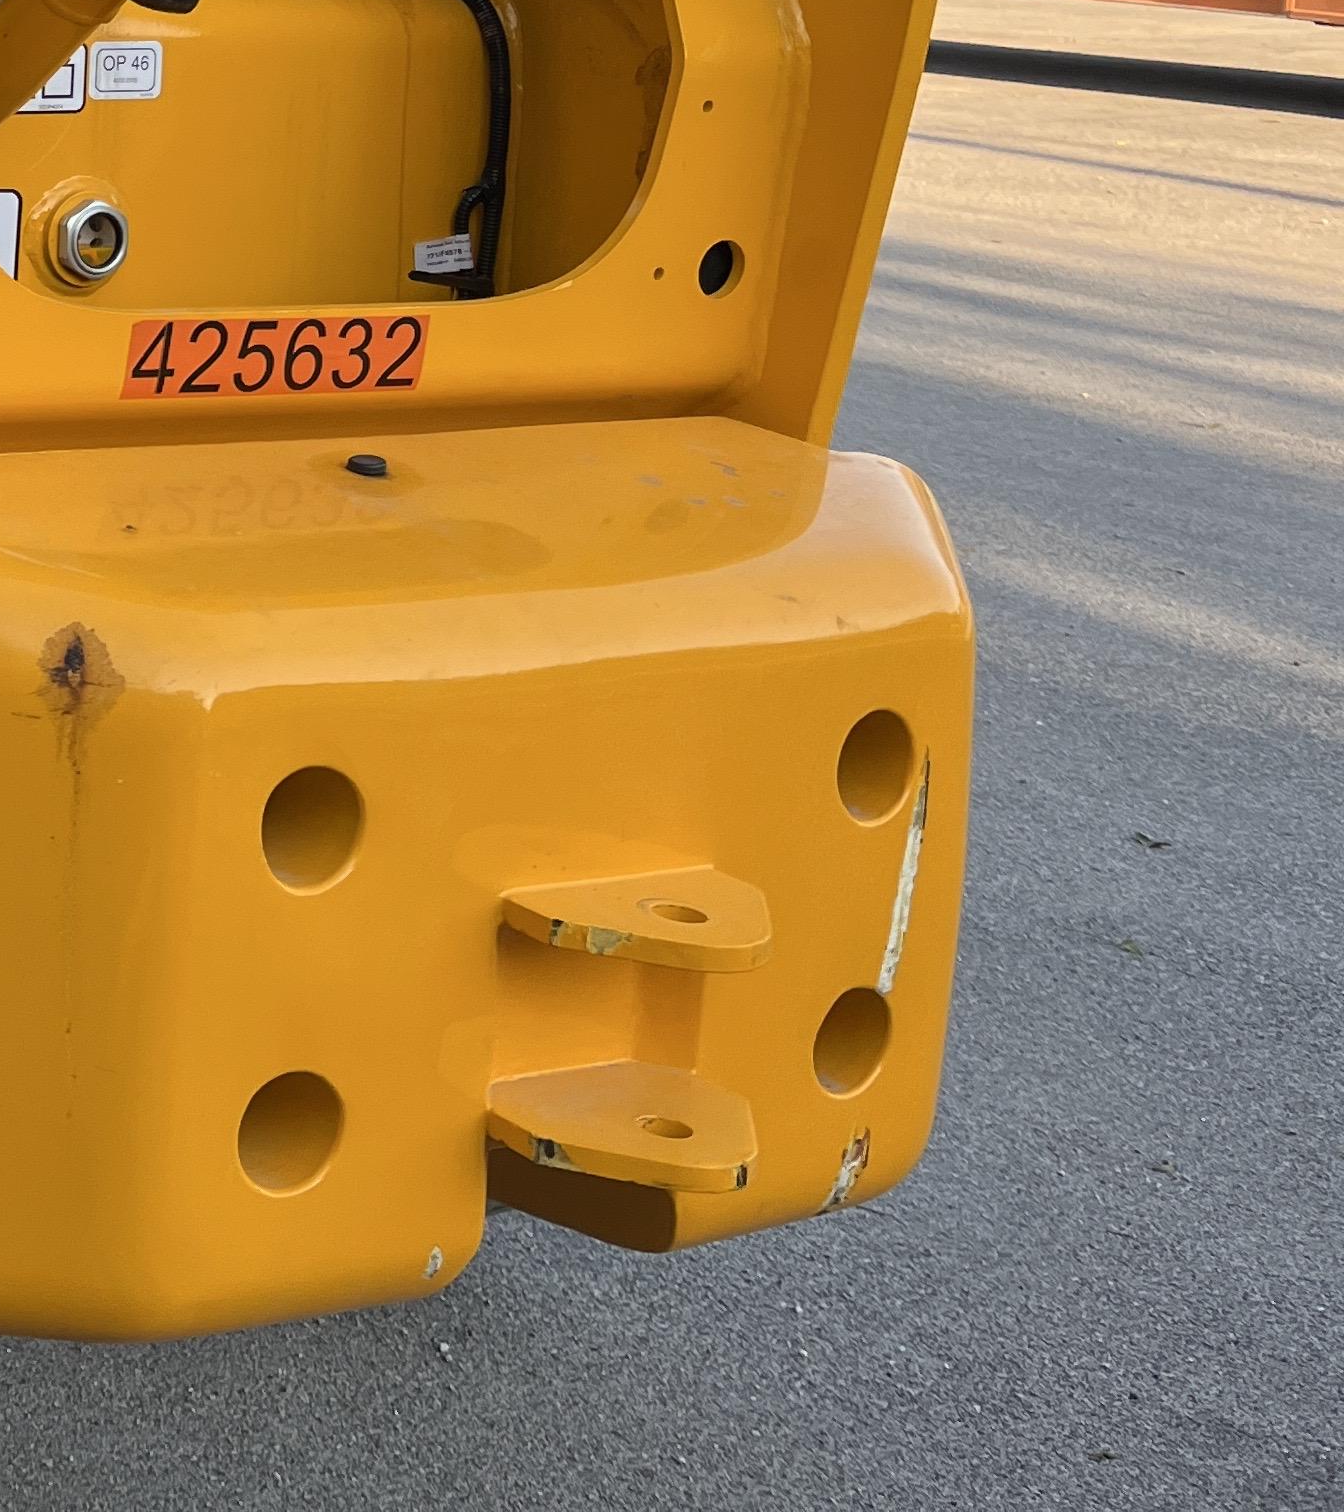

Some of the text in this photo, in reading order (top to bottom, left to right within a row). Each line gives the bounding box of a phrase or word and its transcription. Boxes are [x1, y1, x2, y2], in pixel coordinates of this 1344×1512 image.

[102, 55, 150, 72] OP 46
[130, 315, 423, 394] 425632
